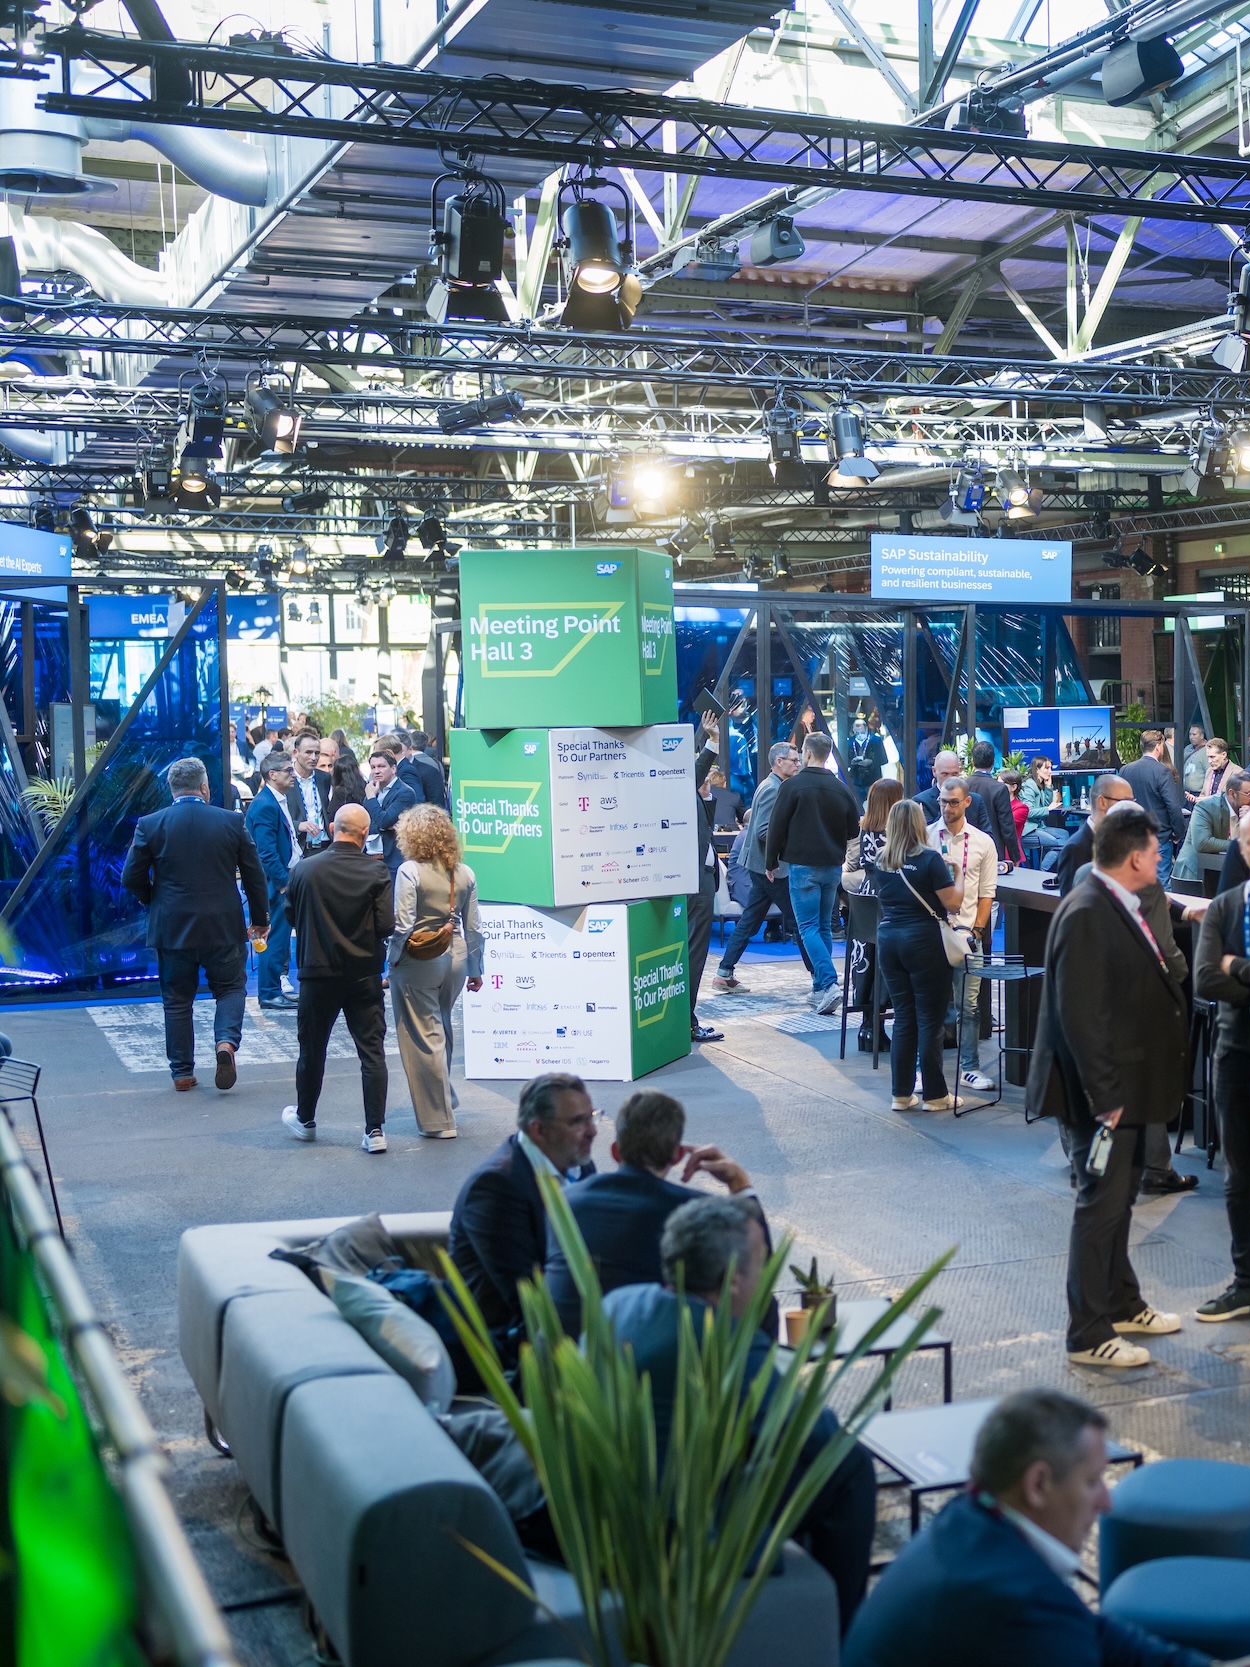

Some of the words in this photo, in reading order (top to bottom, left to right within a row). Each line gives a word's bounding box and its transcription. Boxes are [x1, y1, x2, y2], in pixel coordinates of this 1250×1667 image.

[881, 548, 906, 560] SAP
[908, 549, 989, 565] Sustainability
[1041, 551, 1057, 560] SAP
[5, 555, 15, 570] the
[21, 559, 42, 575] Experts
[597, 564, 617, 574] SAP
[881, 565, 925, 577] Powering
[927, 567, 977, 578] compliant,
[978, 569, 1032, 581] sustainable,
[881, 578, 900, 587] and
[901, 579, 939, 589] resilient
[941, 579, 993, 590] businesses
[131, 614, 165, 624] EMEA
[470, 615, 559, 638] Meeting
[564, 614, 620, 634] Point
[641, 615, 660, 638] Meeting
[661, 616, 672, 635] Point
[471, 642, 514, 661] Hall
[520, 642, 533, 660] 3
[642, 641, 653, 659] Hall
[653, 642, 656, 659] 3
[524, 744, 537, 754] SAP
[557, 741, 590, 753] Special
[592, 740, 624, 749] Thanks
[662, 739, 678, 750] SAP
[558, 753, 568, 763] To
[570, 753, 587, 762] Our
[589, 752, 627, 761] Partners
[577, 772, 600, 782] Syniti
[658, 768, 685, 776] opentext
[600, 796, 617, 804] aws
[456, 798, 497, 818] Special
[498, 799, 539, 817] Thanks
[457, 818, 470, 834] To
[472, 818, 492, 835] Our
[495, 819, 543, 837] Partners
[610, 823, 628, 832] Infosys
[581, 864, 594, 872] IBM
[482, 920, 505, 928] ecial
[507, 920, 544, 929] Thanks
[588, 921, 607, 931] SAP
[482, 931, 501, 940] Our
[504, 931, 546, 940] Partners
[490, 950, 515, 960] Syniti
[539, 951, 567, 959] Tricentis
[582, 951, 615, 959] opentext
[633, 967, 659, 994] Special
[659, 961, 683, 982] Thanks
[634, 995, 642, 1011] To
[643, 991, 657, 1007] Our
[658, 981, 685, 1002] Partners
[526, 1003, 547, 1011] Infosys
